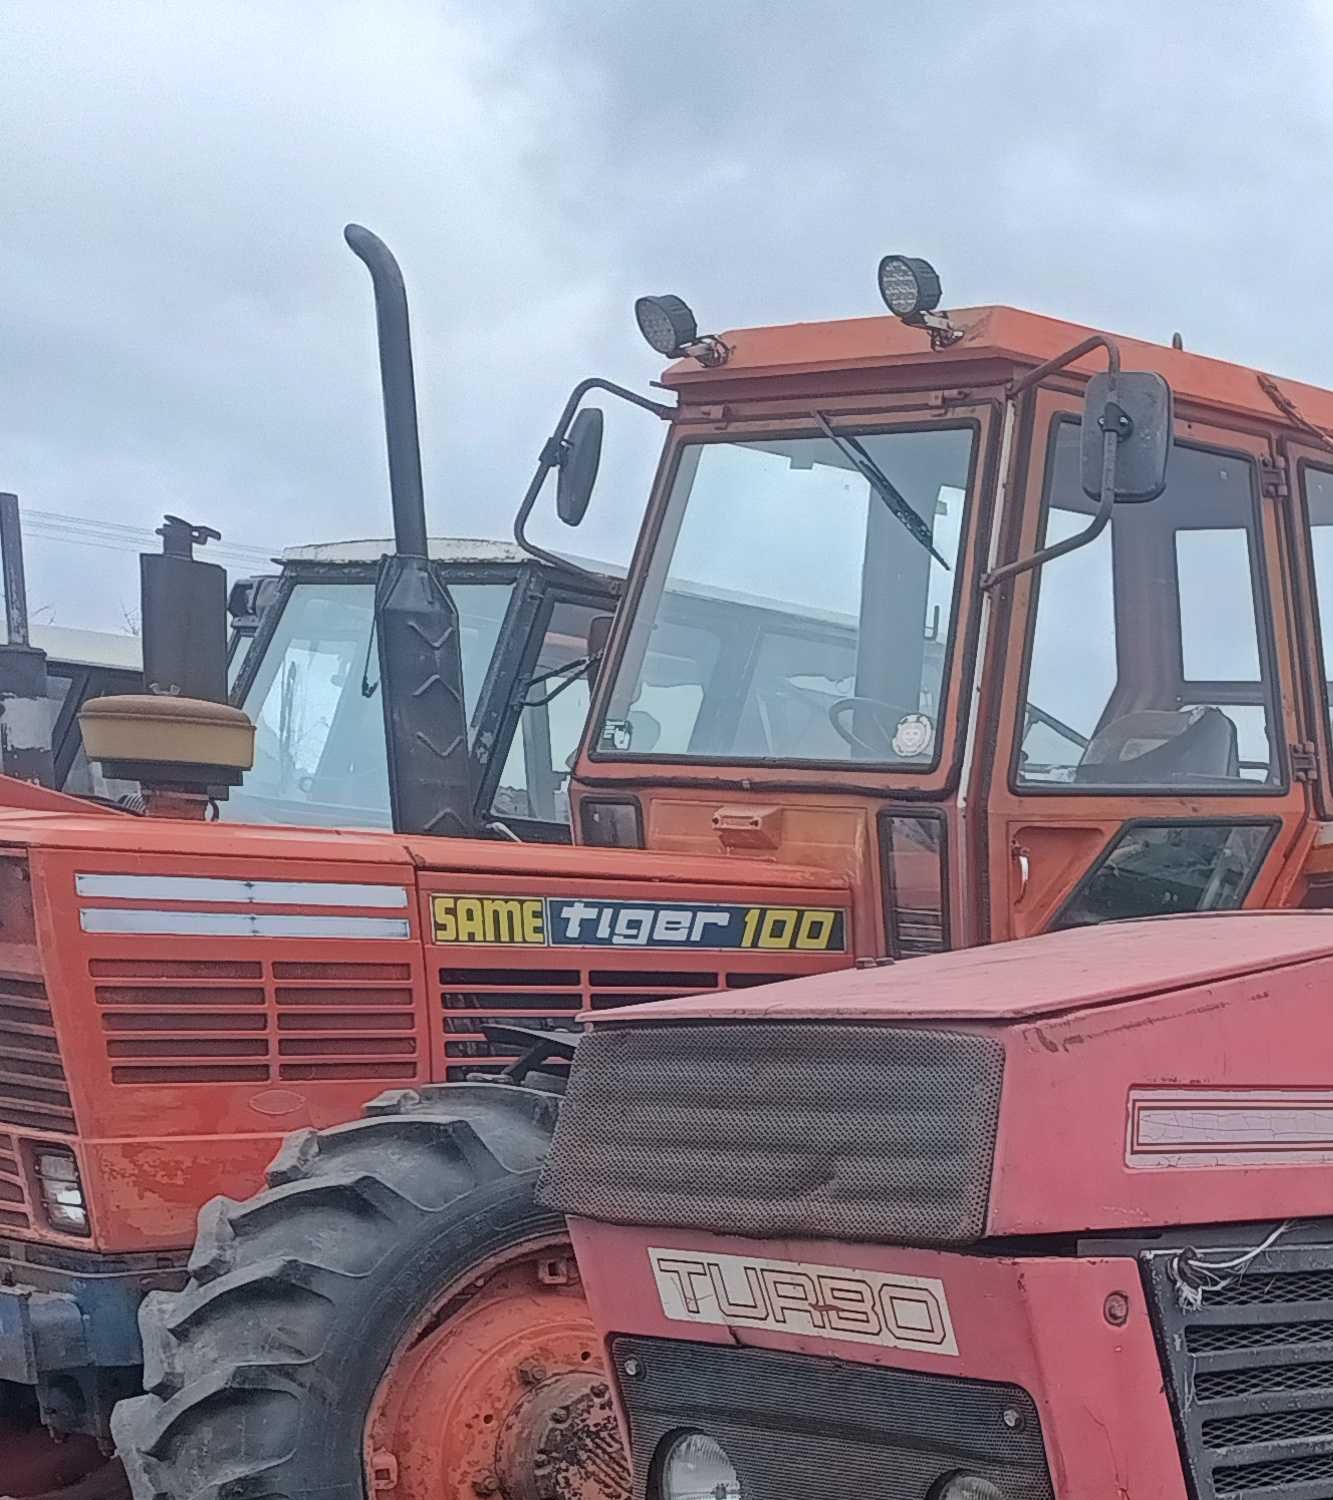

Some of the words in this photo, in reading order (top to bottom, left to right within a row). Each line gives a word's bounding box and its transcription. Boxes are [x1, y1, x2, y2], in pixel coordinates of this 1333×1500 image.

[434, 899, 544, 944] SAME
[560, 902, 730, 945] tiger
[741, 908, 834, 949] 100
[657, 1258, 946, 1344] TURBO
